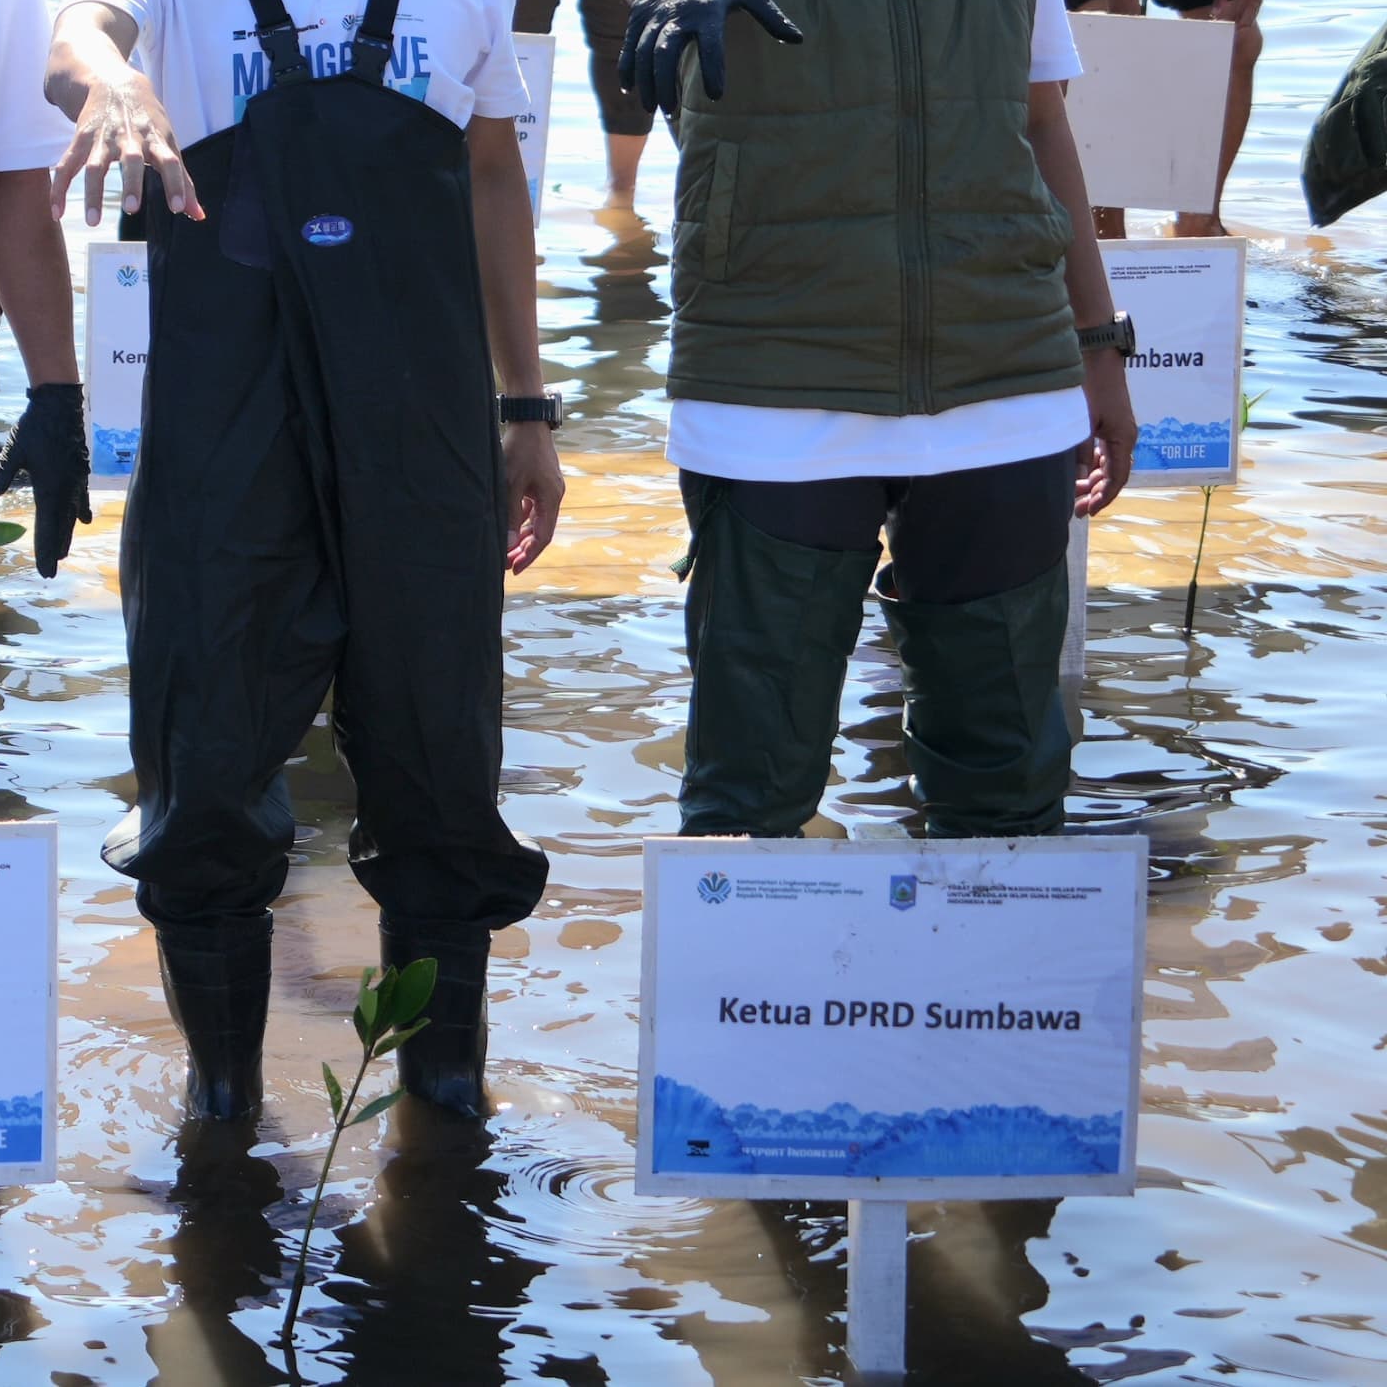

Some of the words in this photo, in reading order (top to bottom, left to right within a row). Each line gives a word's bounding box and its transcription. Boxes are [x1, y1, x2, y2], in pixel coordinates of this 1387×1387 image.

[514, 113, 536, 124] rah
[112, 350, 147, 364] Kem
[1124, 347, 1204, 368] mbawa
[1183, 444, 1206, 459] LIFE
[719, 997, 812, 1026] Ketua
[824, 999, 915, 1028] DPRD
[925, 1002, 1081, 1031] Sumbawa
[787, 1146, 847, 1159] INDONESIA
